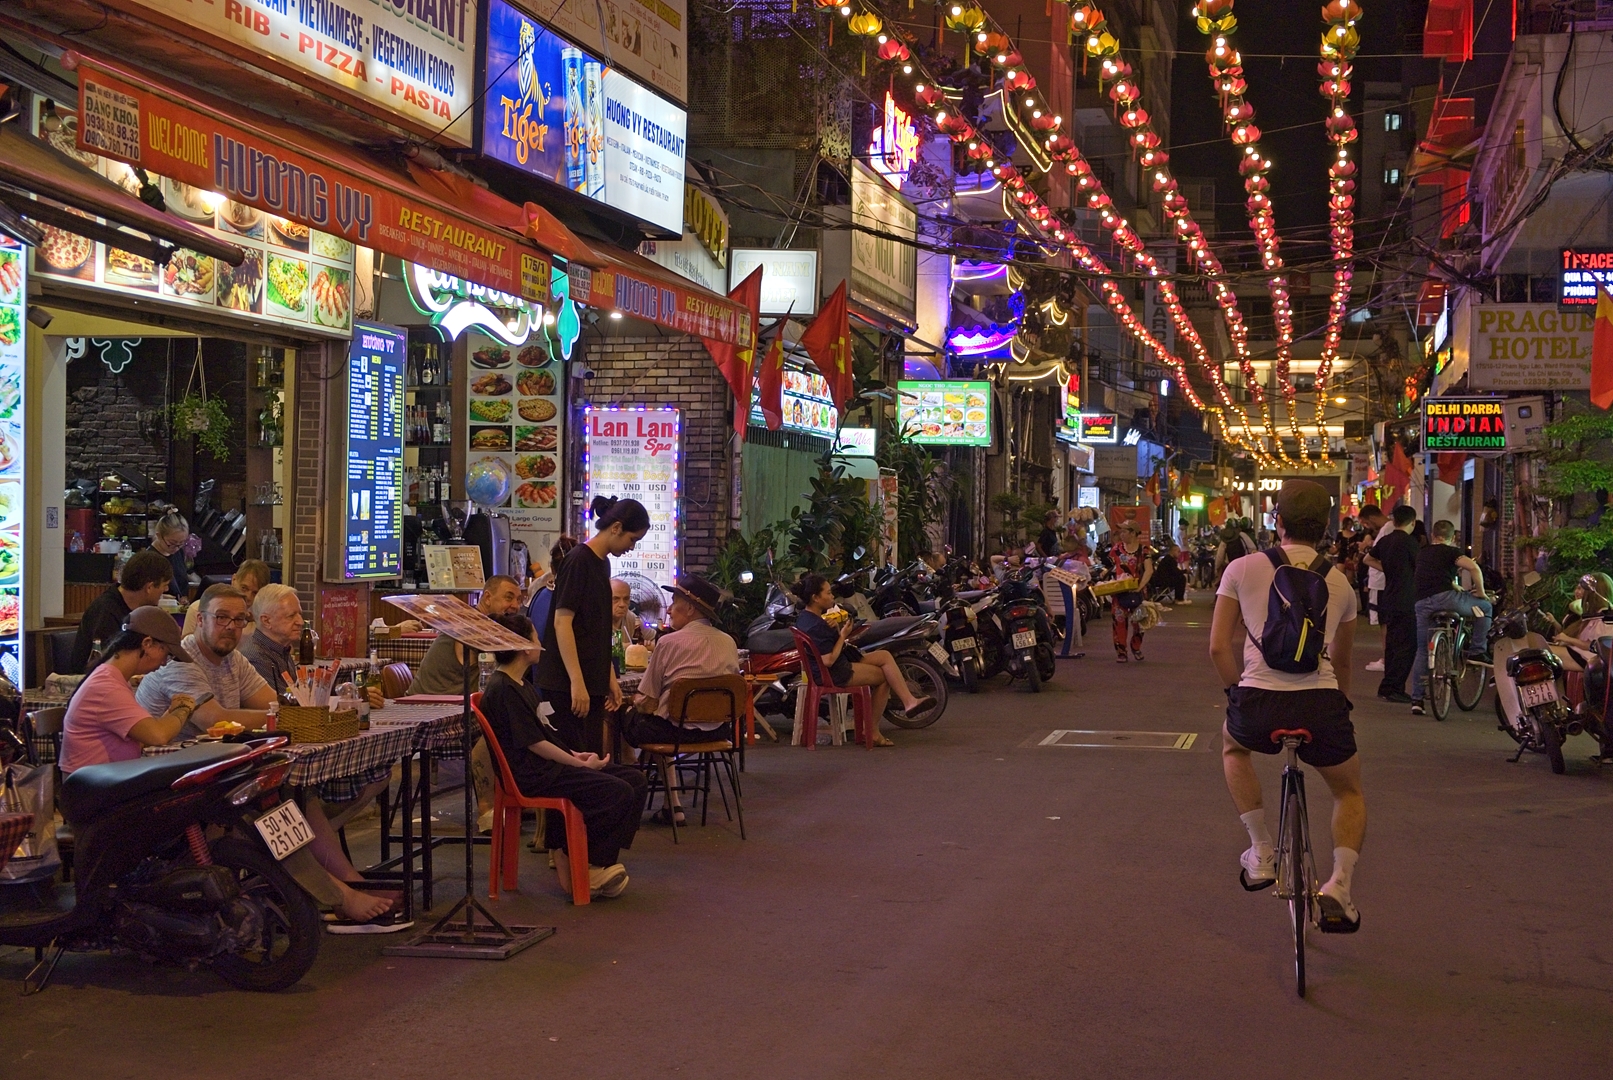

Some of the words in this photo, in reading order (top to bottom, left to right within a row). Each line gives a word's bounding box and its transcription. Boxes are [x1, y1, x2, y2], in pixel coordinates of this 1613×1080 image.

[225, 0, 271, 36] RIB
[299, 32, 368, 82] PIZZA
[391, 76, 452, 121] PASTA
[300, 0, 363, 53] VIETNAMESE
[372, 24, 427, 84] VEGETARIAN
[428, 53, 455, 98] FOODS
[113, 106, 139, 129] KHOA
[148, 112, 208, 169] WELCOME
[500, 95, 549, 165] Tiger
[632, 111, 642, 136] VY
[643, 117, 685, 159] RESTAURANT
[213, 132, 330, 227] HƯƠNG
[335, 181, 373, 242] VY
[399, 206, 507, 262] RESTAURANT
[524, 256, 545, 275] 175/1
[772, 261, 810, 277] NAM
[660, 287, 677, 326] VY
[686, 295, 733, 321] RESTAURANT
[760, 287, 800, 303] OTEL
[1479, 310, 1594, 333] PRAGUE
[1489, 337, 1586, 360] HOTEL
[1427, 404, 1460, 415] DELHI
[593, 416, 628, 437] Lan
[637, 417, 673, 438] Lan
[1428, 417, 1505, 433] INDIAN
[644, 438, 672, 456] Spa
[1427, 436, 1505, 447] RESTAURANT
[592, 470, 638, 482] Massage
[643, 470, 670, 483] Body
[262, 807, 296, 836] 50-N1
[271, 821, 309, 857] 251.07
